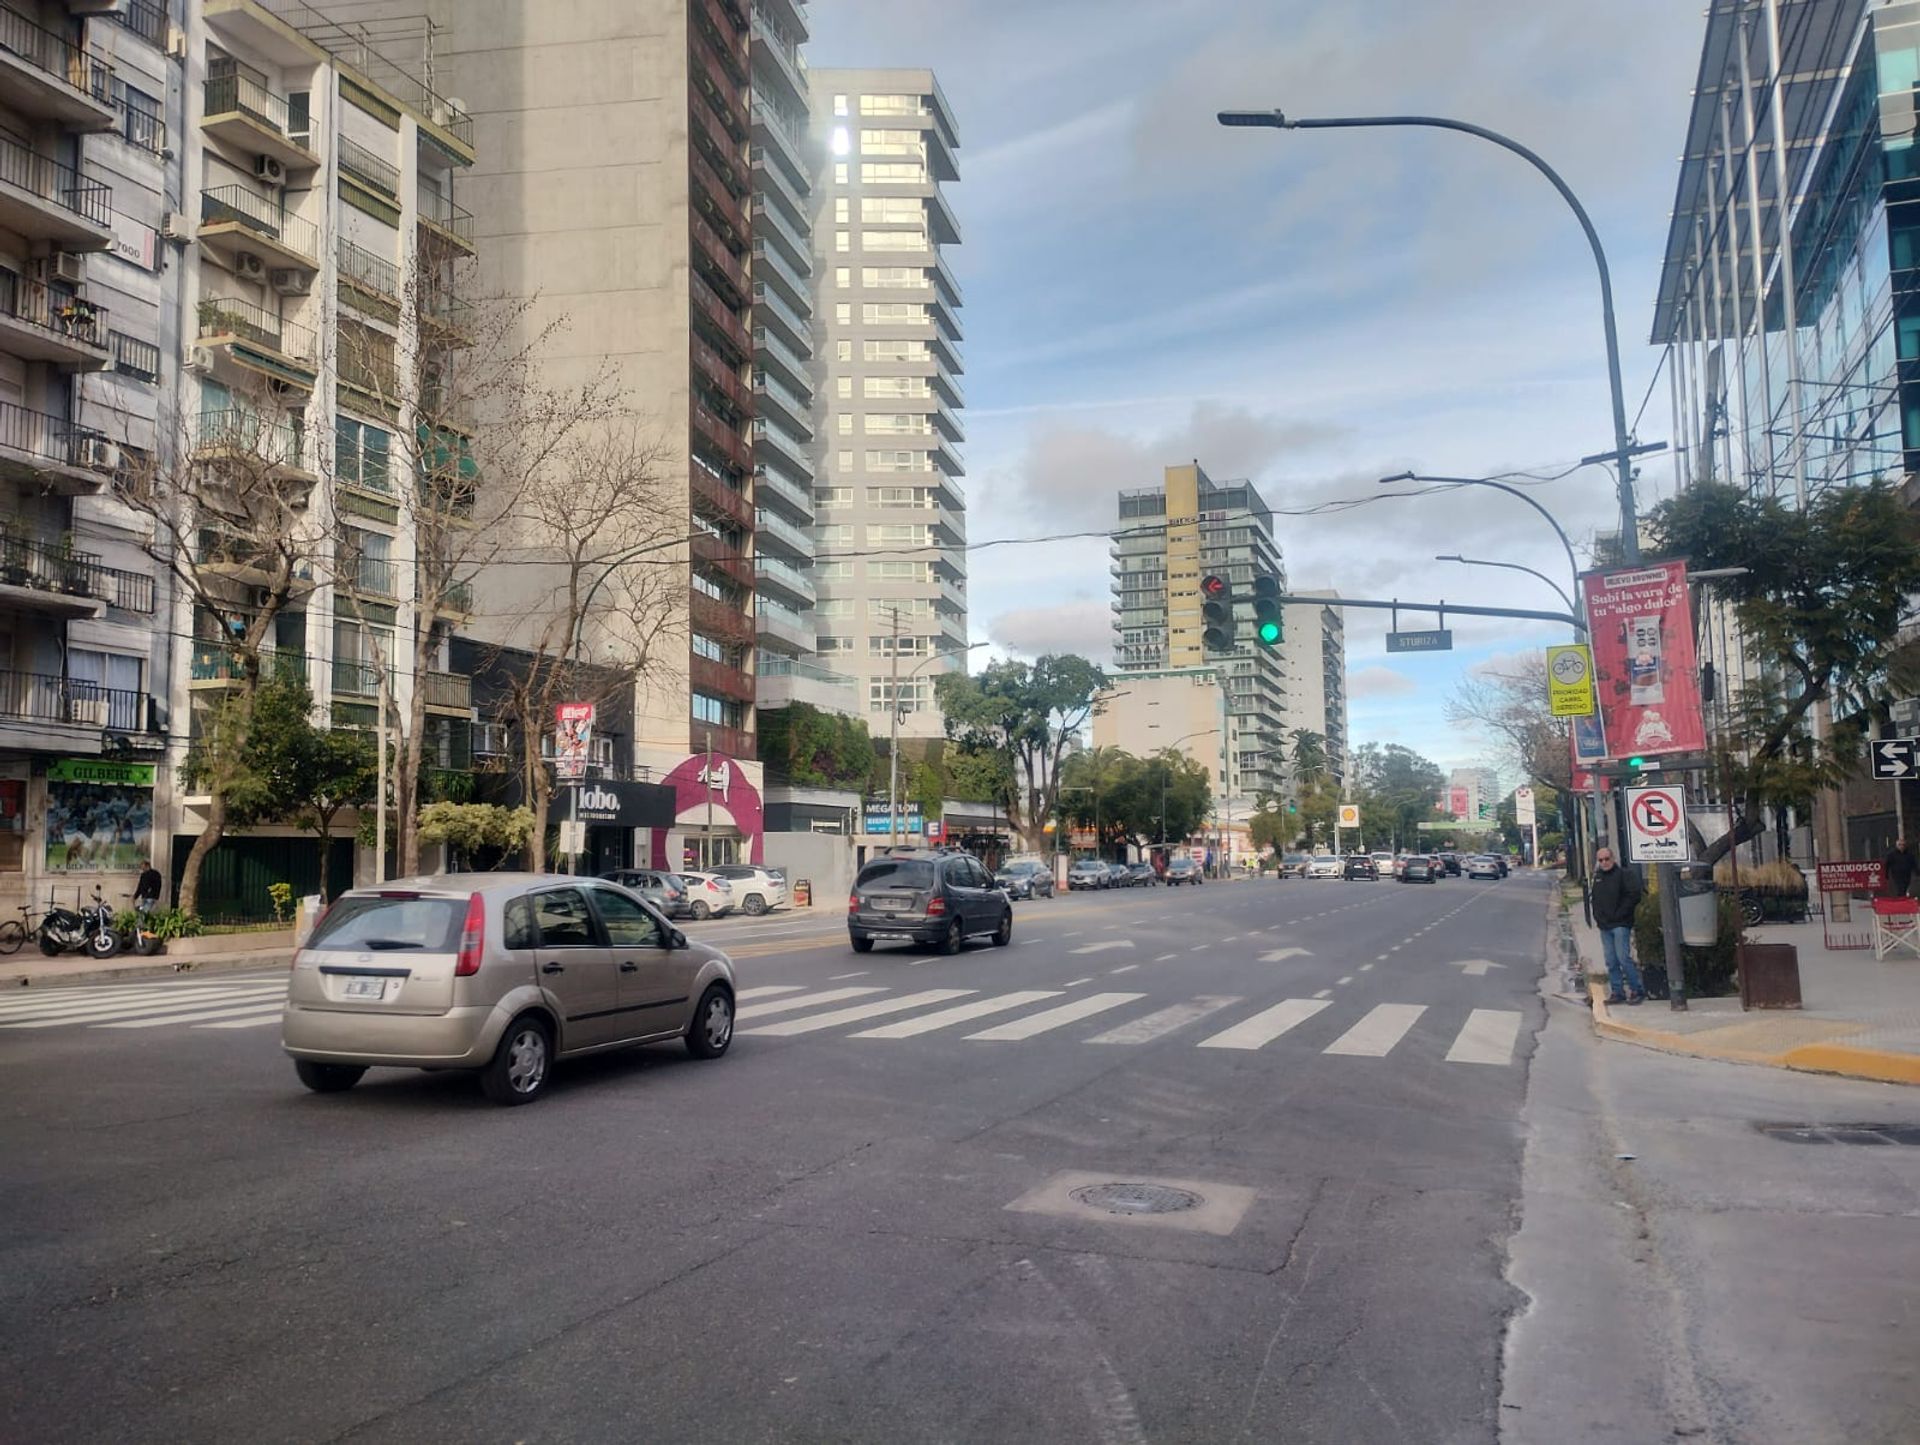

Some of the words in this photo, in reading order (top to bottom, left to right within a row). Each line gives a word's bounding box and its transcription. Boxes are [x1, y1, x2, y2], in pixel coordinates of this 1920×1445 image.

[1621, 590, 1633, 601] la
[1635, 587, 1664, 599] vara
[1668, 583, 1683, 594] de
[1593, 607, 1607, 617] tu
[73, 767, 133, 781] GILBERT
[866, 803, 918, 814] MEGALON
[928, 822, 939, 836] E
[1821, 862, 1881, 873] MAXIKIOSCO
